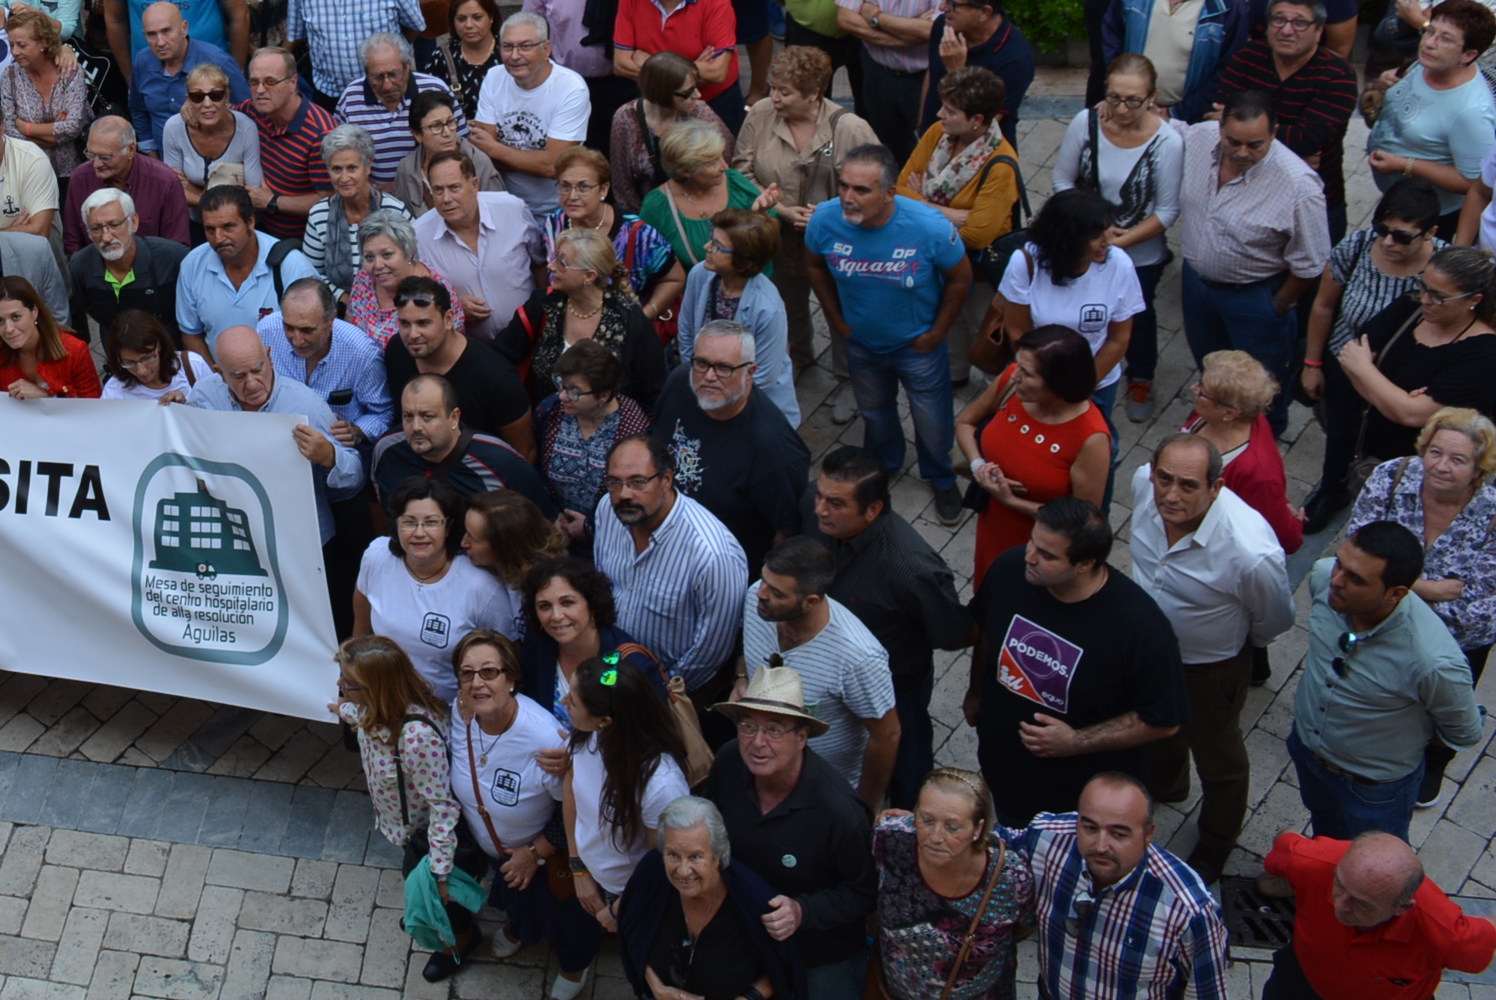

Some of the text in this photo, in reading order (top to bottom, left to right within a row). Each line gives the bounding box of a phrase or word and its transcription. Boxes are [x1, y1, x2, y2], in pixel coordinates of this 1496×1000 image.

[145, 574, 273, 598] Mesa de seguimiento
[146, 590, 274, 613] del centro hospitalario
[153, 603, 254, 625] de alta resolución
[182, 619, 236, 643] Águilas
[1041, 690, 1064, 706] equo
